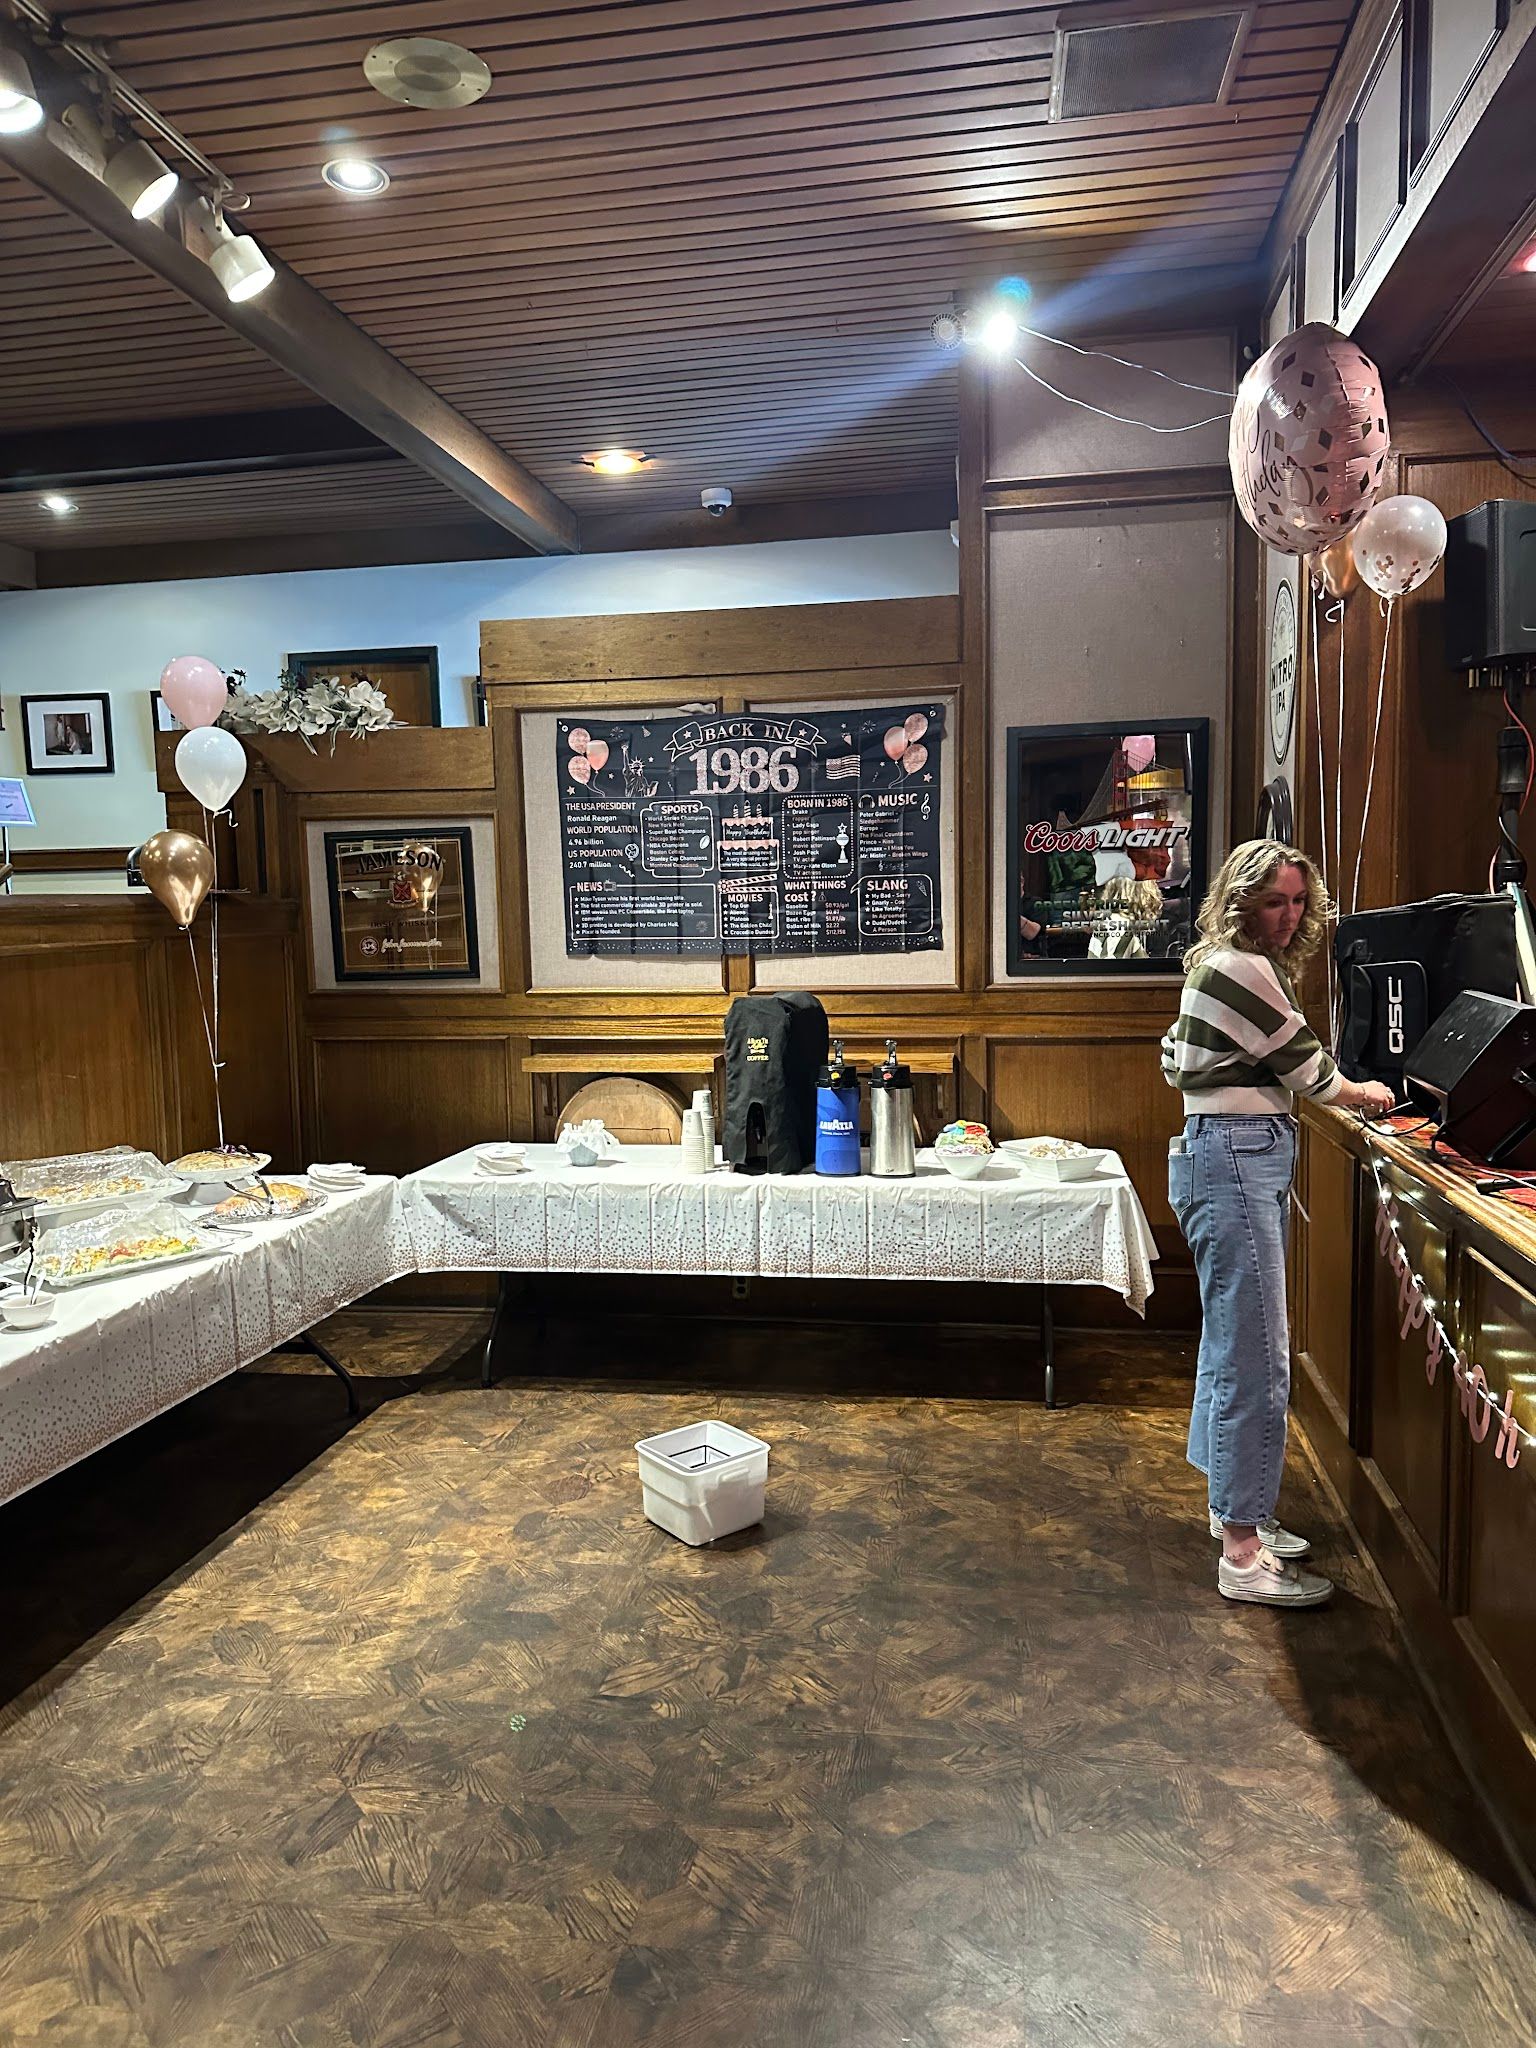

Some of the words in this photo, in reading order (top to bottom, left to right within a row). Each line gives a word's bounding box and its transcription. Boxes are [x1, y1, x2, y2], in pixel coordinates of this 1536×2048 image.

[1271, 653, 1293, 691] NITRO
[1275, 690, 1286, 716] IPA
[704, 723, 754, 741] BACK
[764, 725, 785, 739] IN
[689, 746, 799, 795] 1986
[788, 799, 814, 808] BORN
[815, 799, 824, 807] IN
[827, 798, 848, 807] 1986
[878, 793, 917, 807] MUSIC
[661, 804, 699, 814] SPORTS
[1024, 821, 1099, 854] Coors
[1100, 826, 1187, 848] LIGHT
[355, 849, 442, 874] JAMESON
[577, 882, 603, 892] NEWS
[785, 881, 810, 890] WHAT
[812, 880, 846, 889] THINGS
[867, 880, 908, 891] SLANG
[728, 894, 763, 902] MOVIES
[785, 892, 808, 902] cost
[811, 891, 816, 902] ?
[1063, 910, 1112, 921] SILVER
[1062, 919, 1170, 932] REFRESHMENT
[1388, 976, 1404, 1054] QSC
[820, 1118, 854, 1130] LAVAZZA
